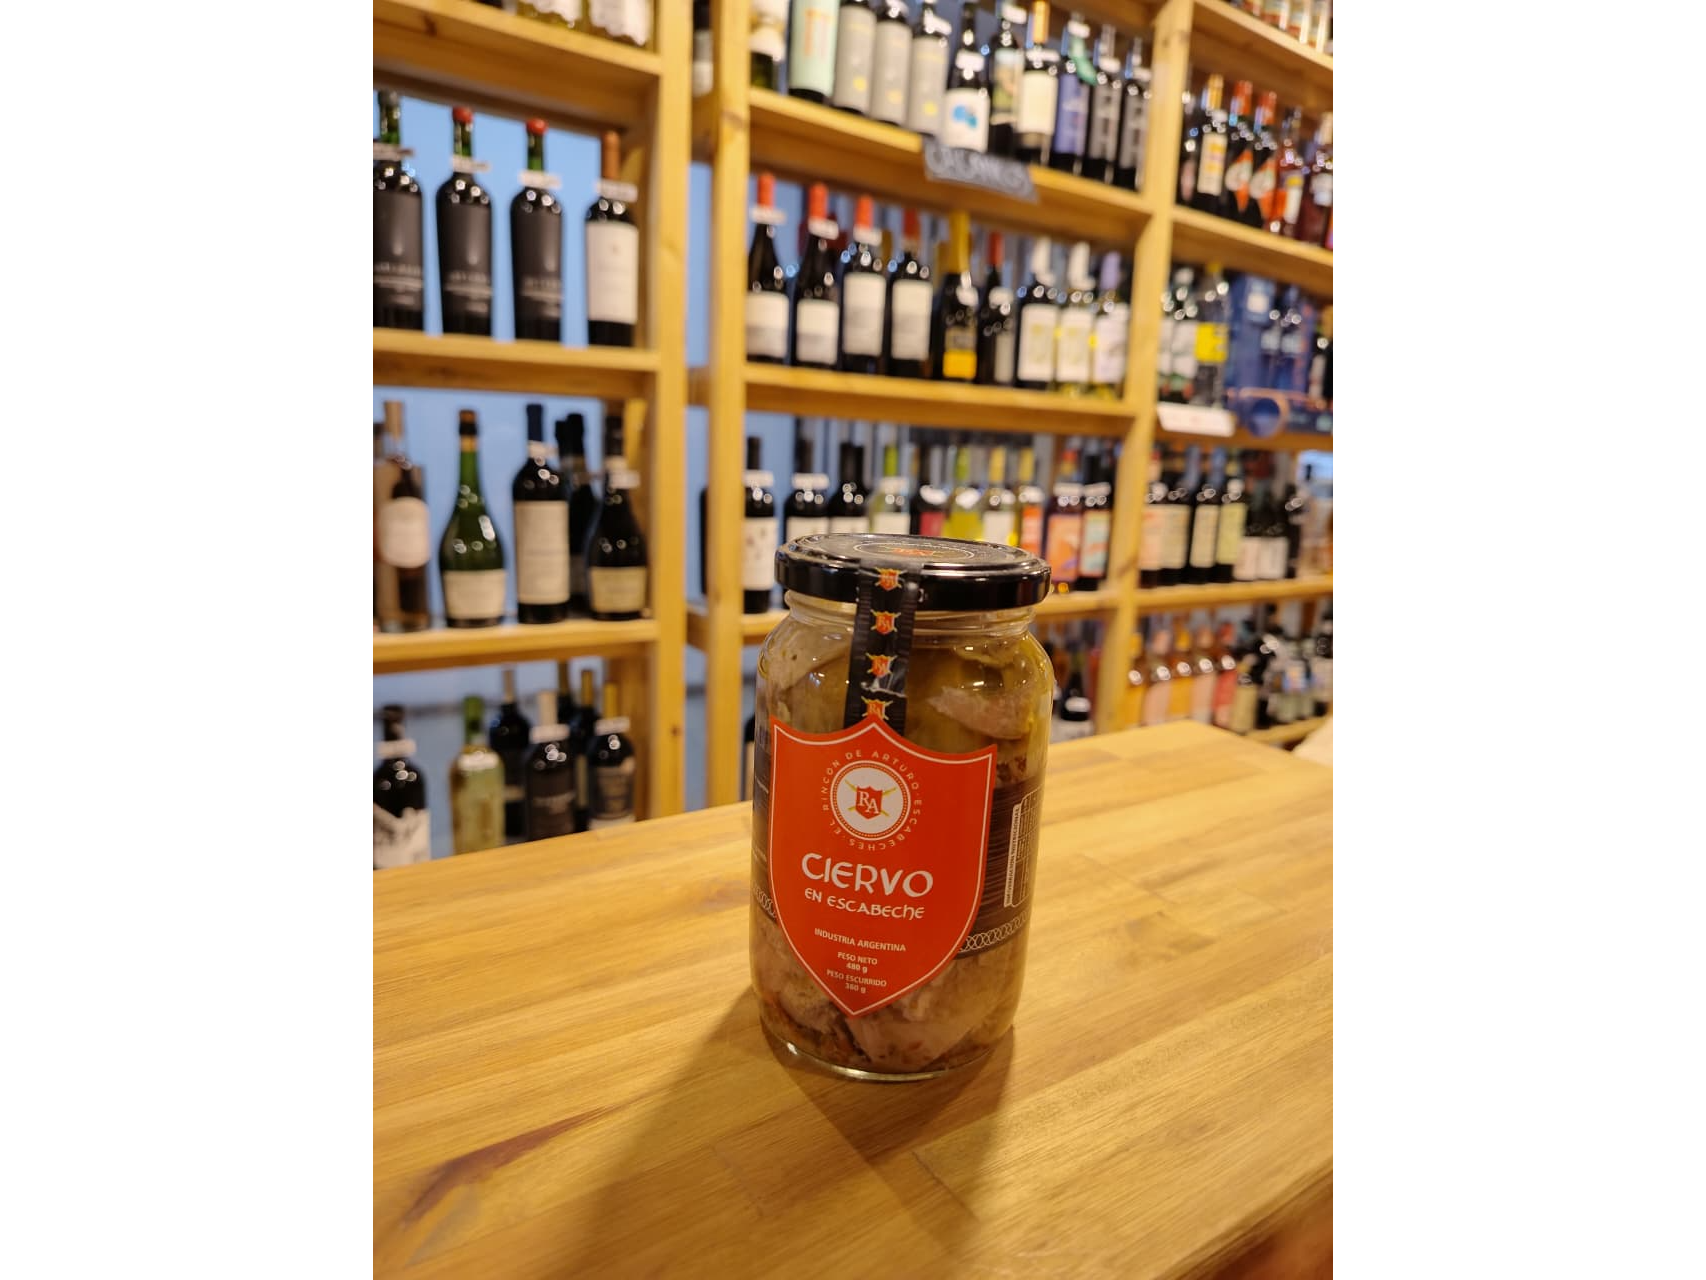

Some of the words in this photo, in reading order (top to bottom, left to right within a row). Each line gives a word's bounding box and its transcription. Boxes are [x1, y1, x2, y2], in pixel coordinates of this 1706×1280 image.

[845, 749, 862, 760] DE
[871, 750, 919, 790] ARTURO
[858, 790, 879, 814] RA
[829, 819, 841, 835] EL
[849, 799, 923, 851] ESCABECHES
[801, 852, 934, 898] CIERVO
[804, 887, 822, 903] EN
[827, 895, 925, 921] ESCABECHE
[814, 928, 855, 946] INDUSTRIA
[857, 940, 906, 952] ARGENTINA
[837, 951, 856, 962] PESO
[858, 956, 878, 965] NETO
[846, 962, 860, 970] 480
[862, 966, 868, 974] g
[826, 969, 844, 979] PESO
[846, 974, 887, 987] ESCURRIDO
